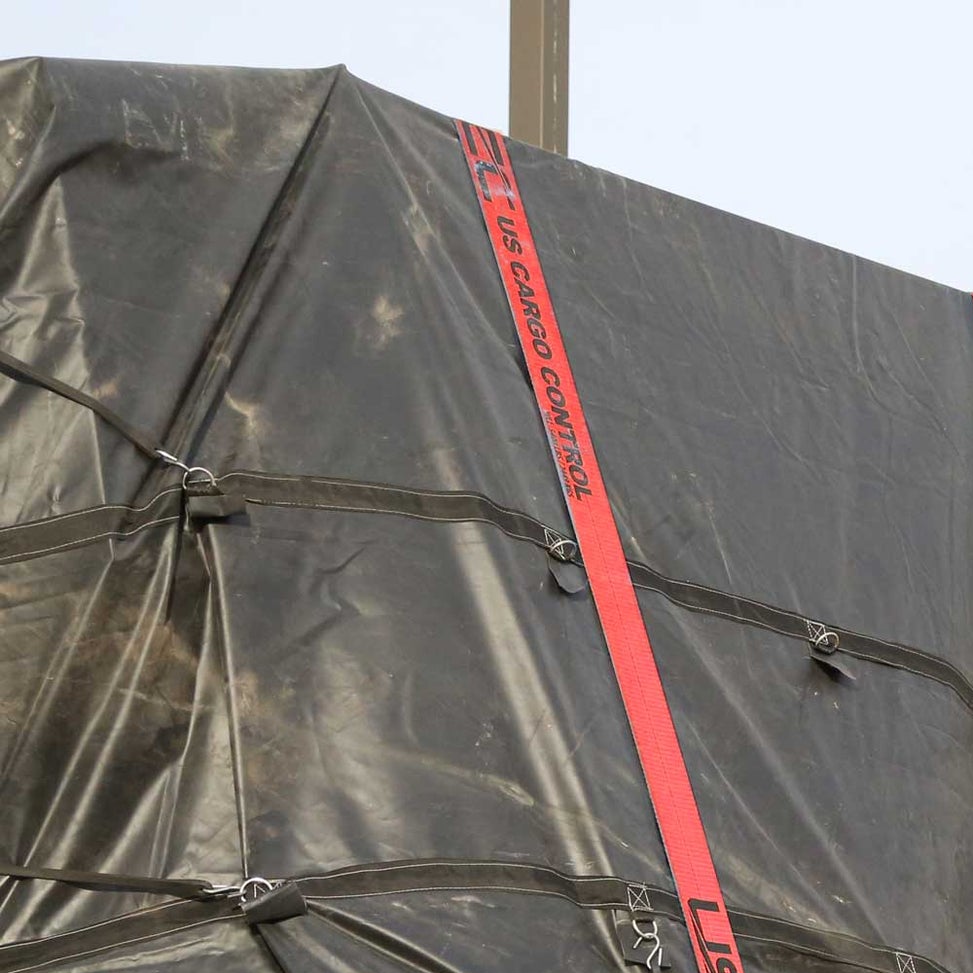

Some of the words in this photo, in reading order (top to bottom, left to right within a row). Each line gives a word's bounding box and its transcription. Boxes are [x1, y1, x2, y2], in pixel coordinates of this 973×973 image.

[497, 215, 523, 256] US
[511, 259, 552, 361] CARGO
[541, 366, 593, 502] CONTROL
